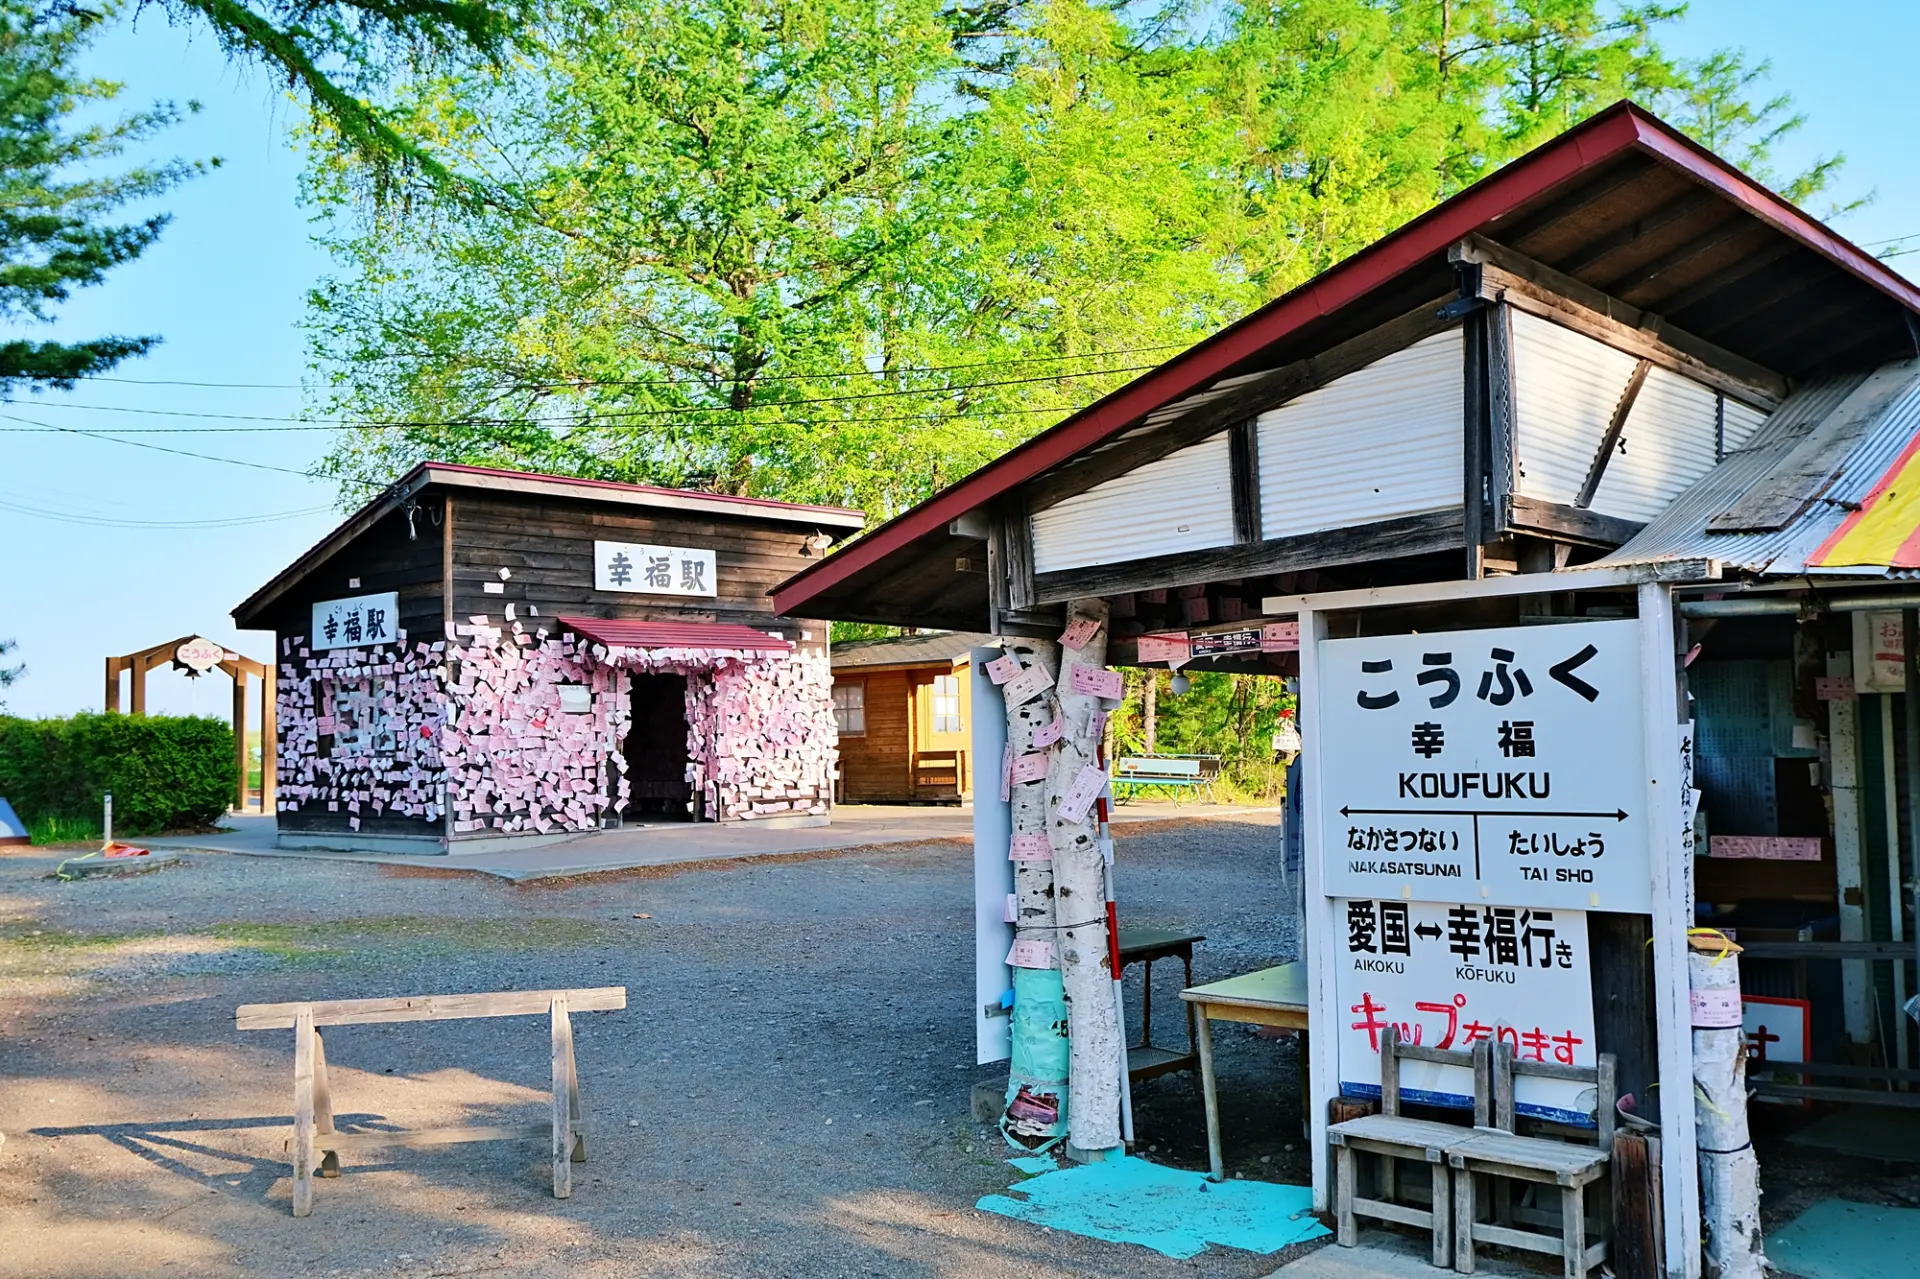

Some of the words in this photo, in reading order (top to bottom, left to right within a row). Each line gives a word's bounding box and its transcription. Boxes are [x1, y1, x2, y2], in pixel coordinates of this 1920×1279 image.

[607, 551, 707, 592] 幸福駅
[323, 608, 387, 645] 幸福駅
[180, 648, 221, 659] こうふく
[1356, 643, 1600, 710] こうふく
[1411, 720, 1536, 759] 幸福
[1399, 772, 1550, 799] KOUFUKU
[1347, 826, 1459, 852] なかさつない
[1508, 830, 1605, 858] たいしょう
[1348, 861, 1462, 878] NAKASATSUNAI
[1347, 899, 1411, 957] 愛国
[1447, 904, 1573, 969] 幸福行き
[1354, 958, 1405, 974] AIKOKU
[1455, 964, 1517, 985] KŌFUKU
